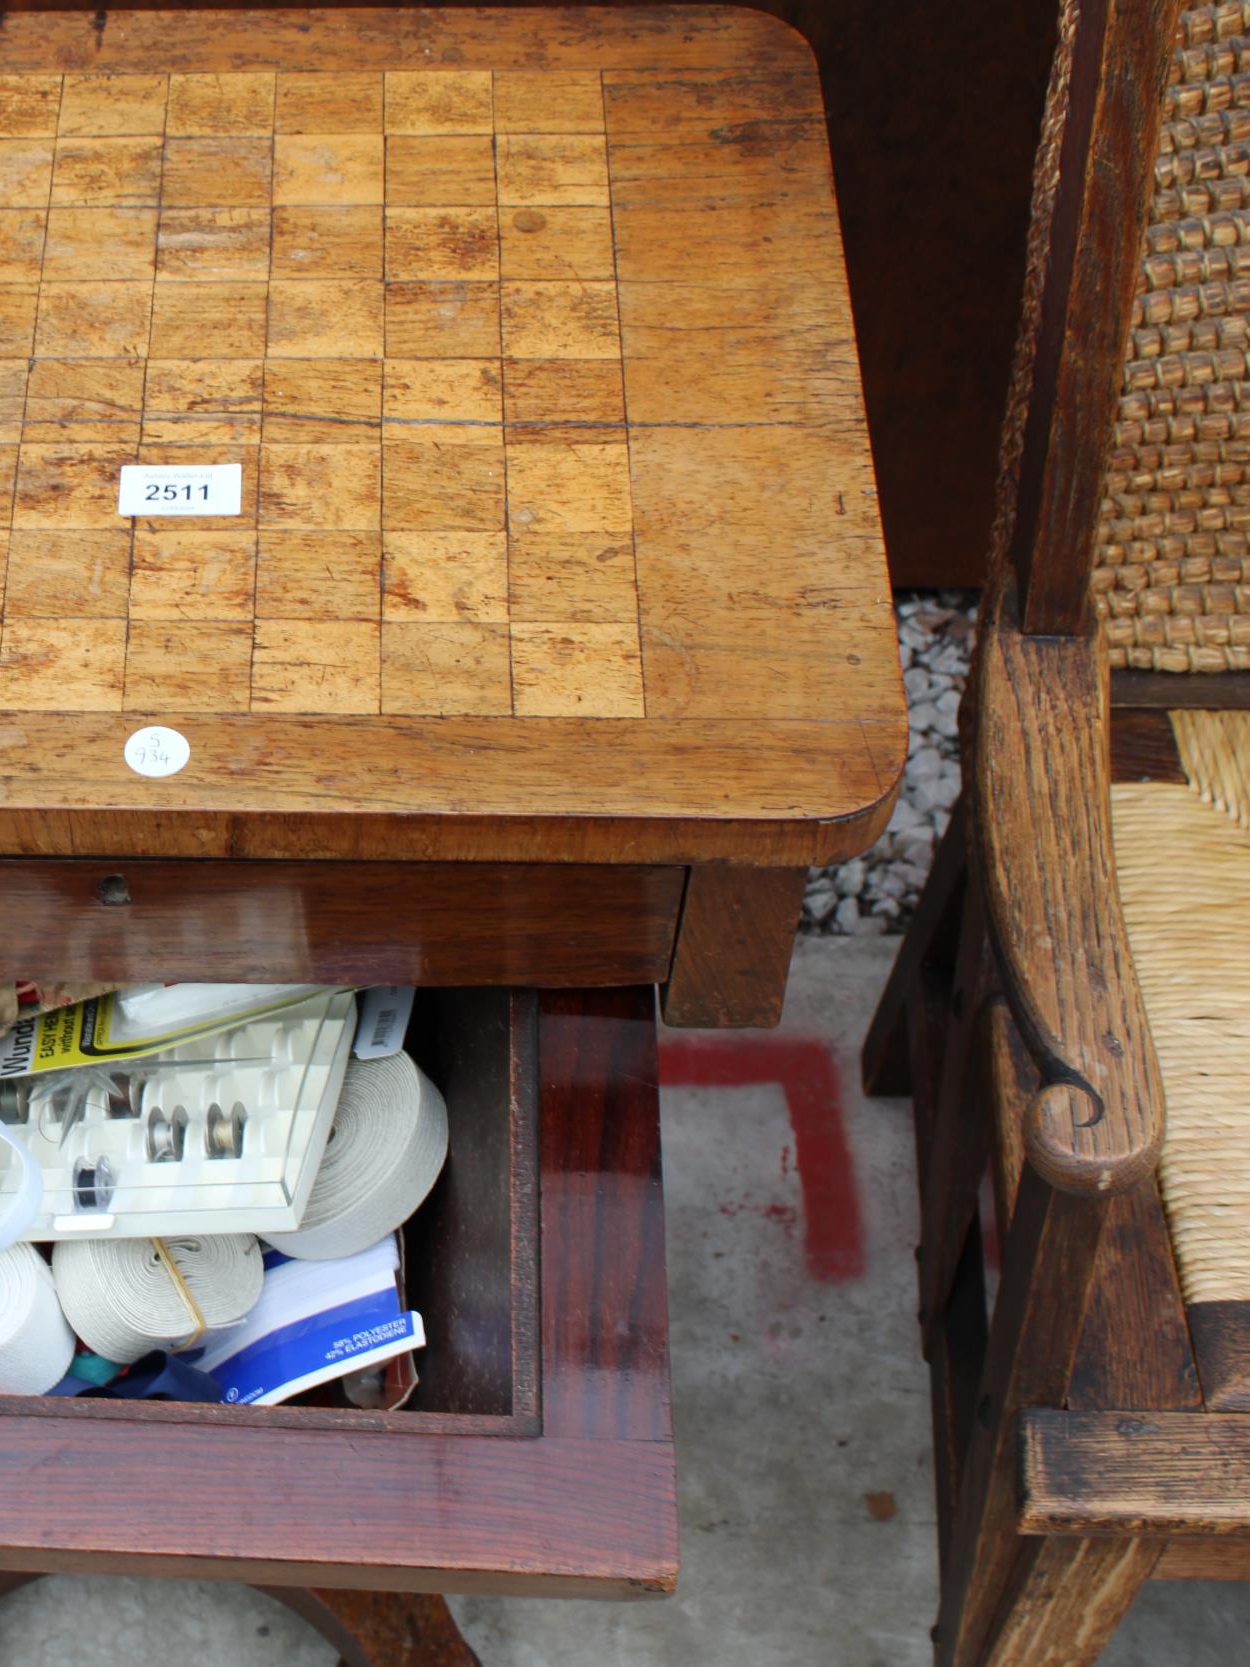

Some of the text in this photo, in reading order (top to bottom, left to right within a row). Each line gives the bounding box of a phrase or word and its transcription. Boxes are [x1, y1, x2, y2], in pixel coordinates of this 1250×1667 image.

[144, 484, 209, 501] 2511
[40, 1033, 57, 1059] EASY
[61, 1017, 75, 1054] without
[345, 1327, 407, 1353] ELASTODIENE
[352, 1318, 407, 1341] POLYESTER
